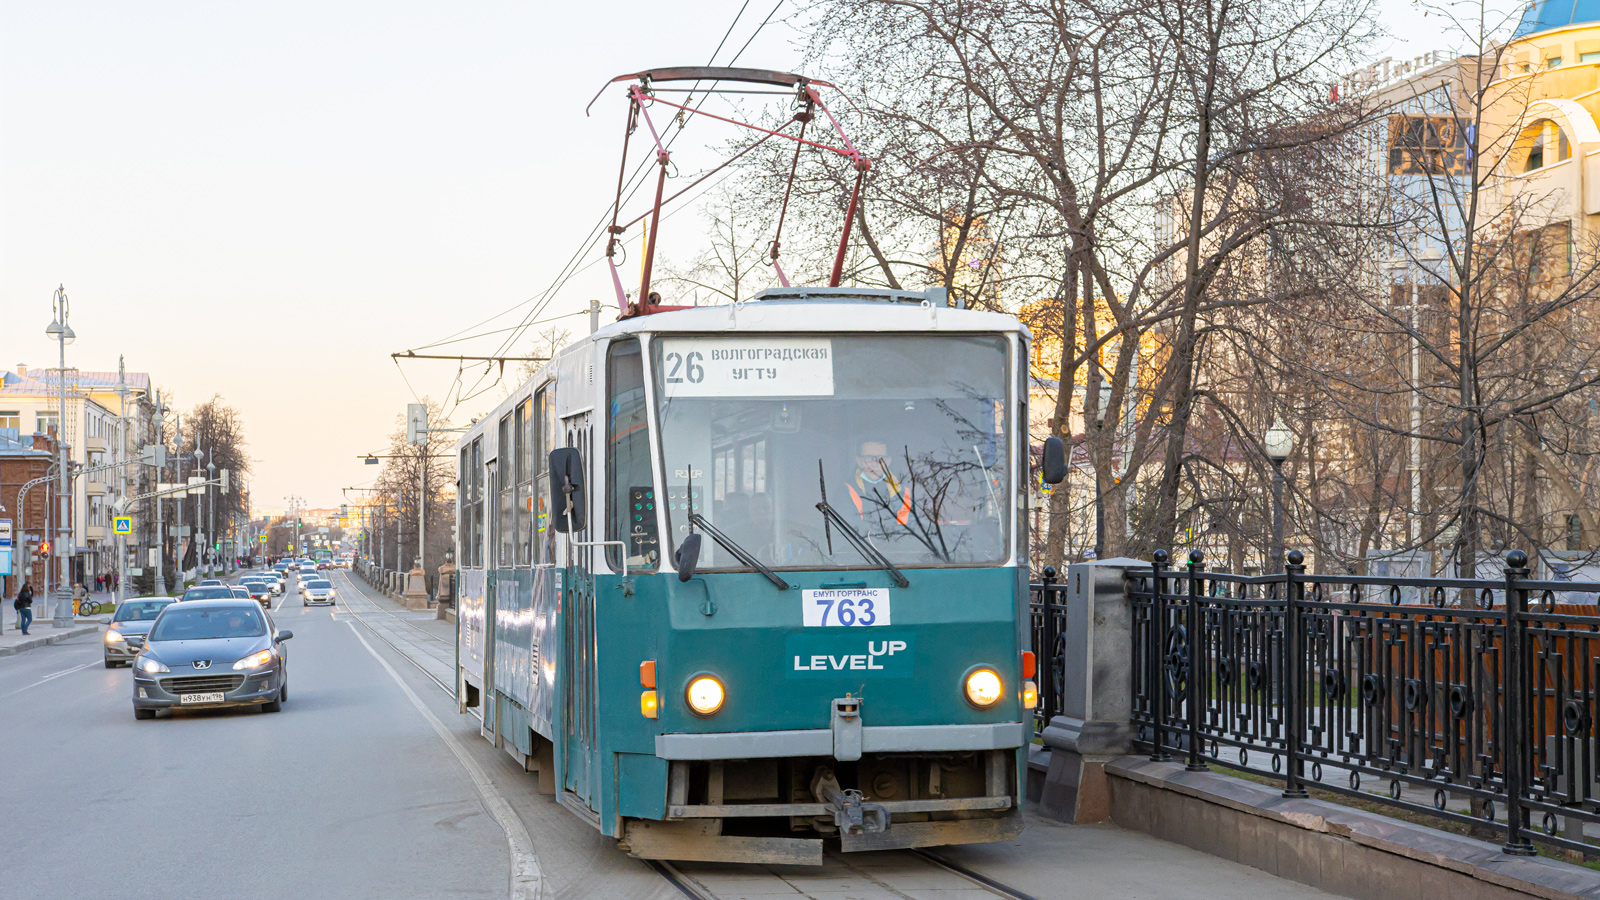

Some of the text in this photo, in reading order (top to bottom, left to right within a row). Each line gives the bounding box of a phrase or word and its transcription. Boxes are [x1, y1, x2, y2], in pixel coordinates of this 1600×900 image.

[665, 351, 704, 384] 26
[732, 368, 777, 380] УГТУ
[816, 598, 876, 627] 763
[794, 640, 907, 671] LEVEL UP
